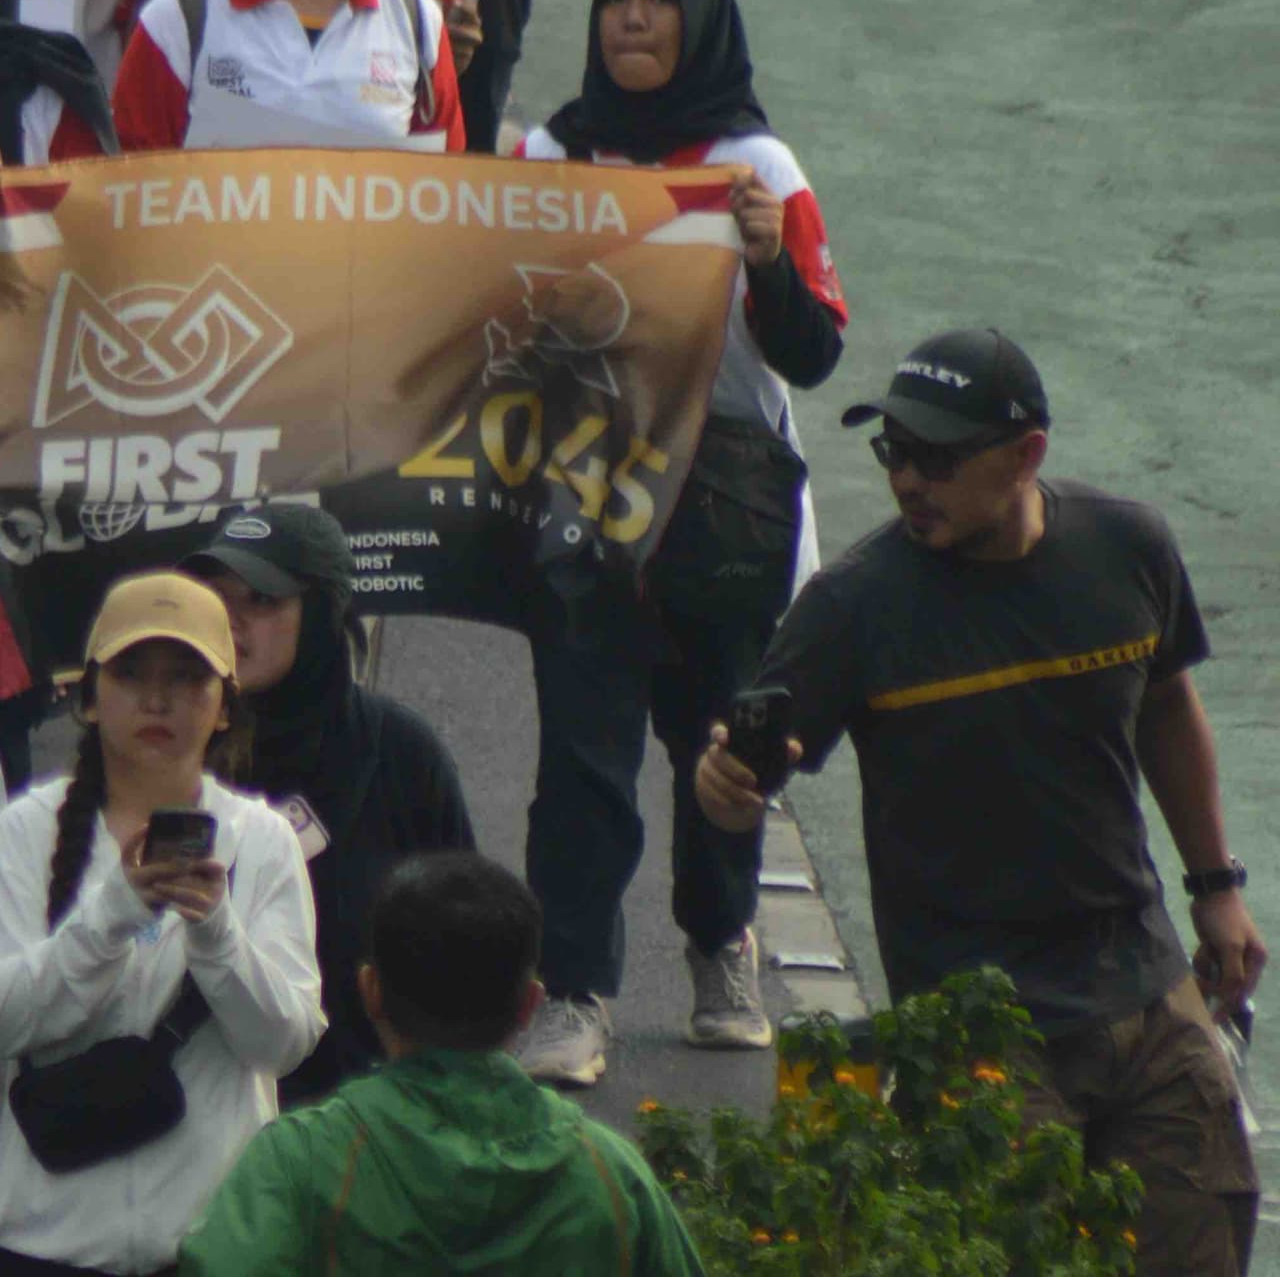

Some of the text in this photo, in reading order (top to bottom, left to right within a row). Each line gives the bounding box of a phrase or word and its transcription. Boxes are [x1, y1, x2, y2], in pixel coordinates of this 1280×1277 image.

[105, 175, 629, 237] TEAM INDONESIA
[40, 426, 281, 504] FIRST
[348, 531, 440, 549] NDONESIA
[355, 554, 394, 571] IRST
